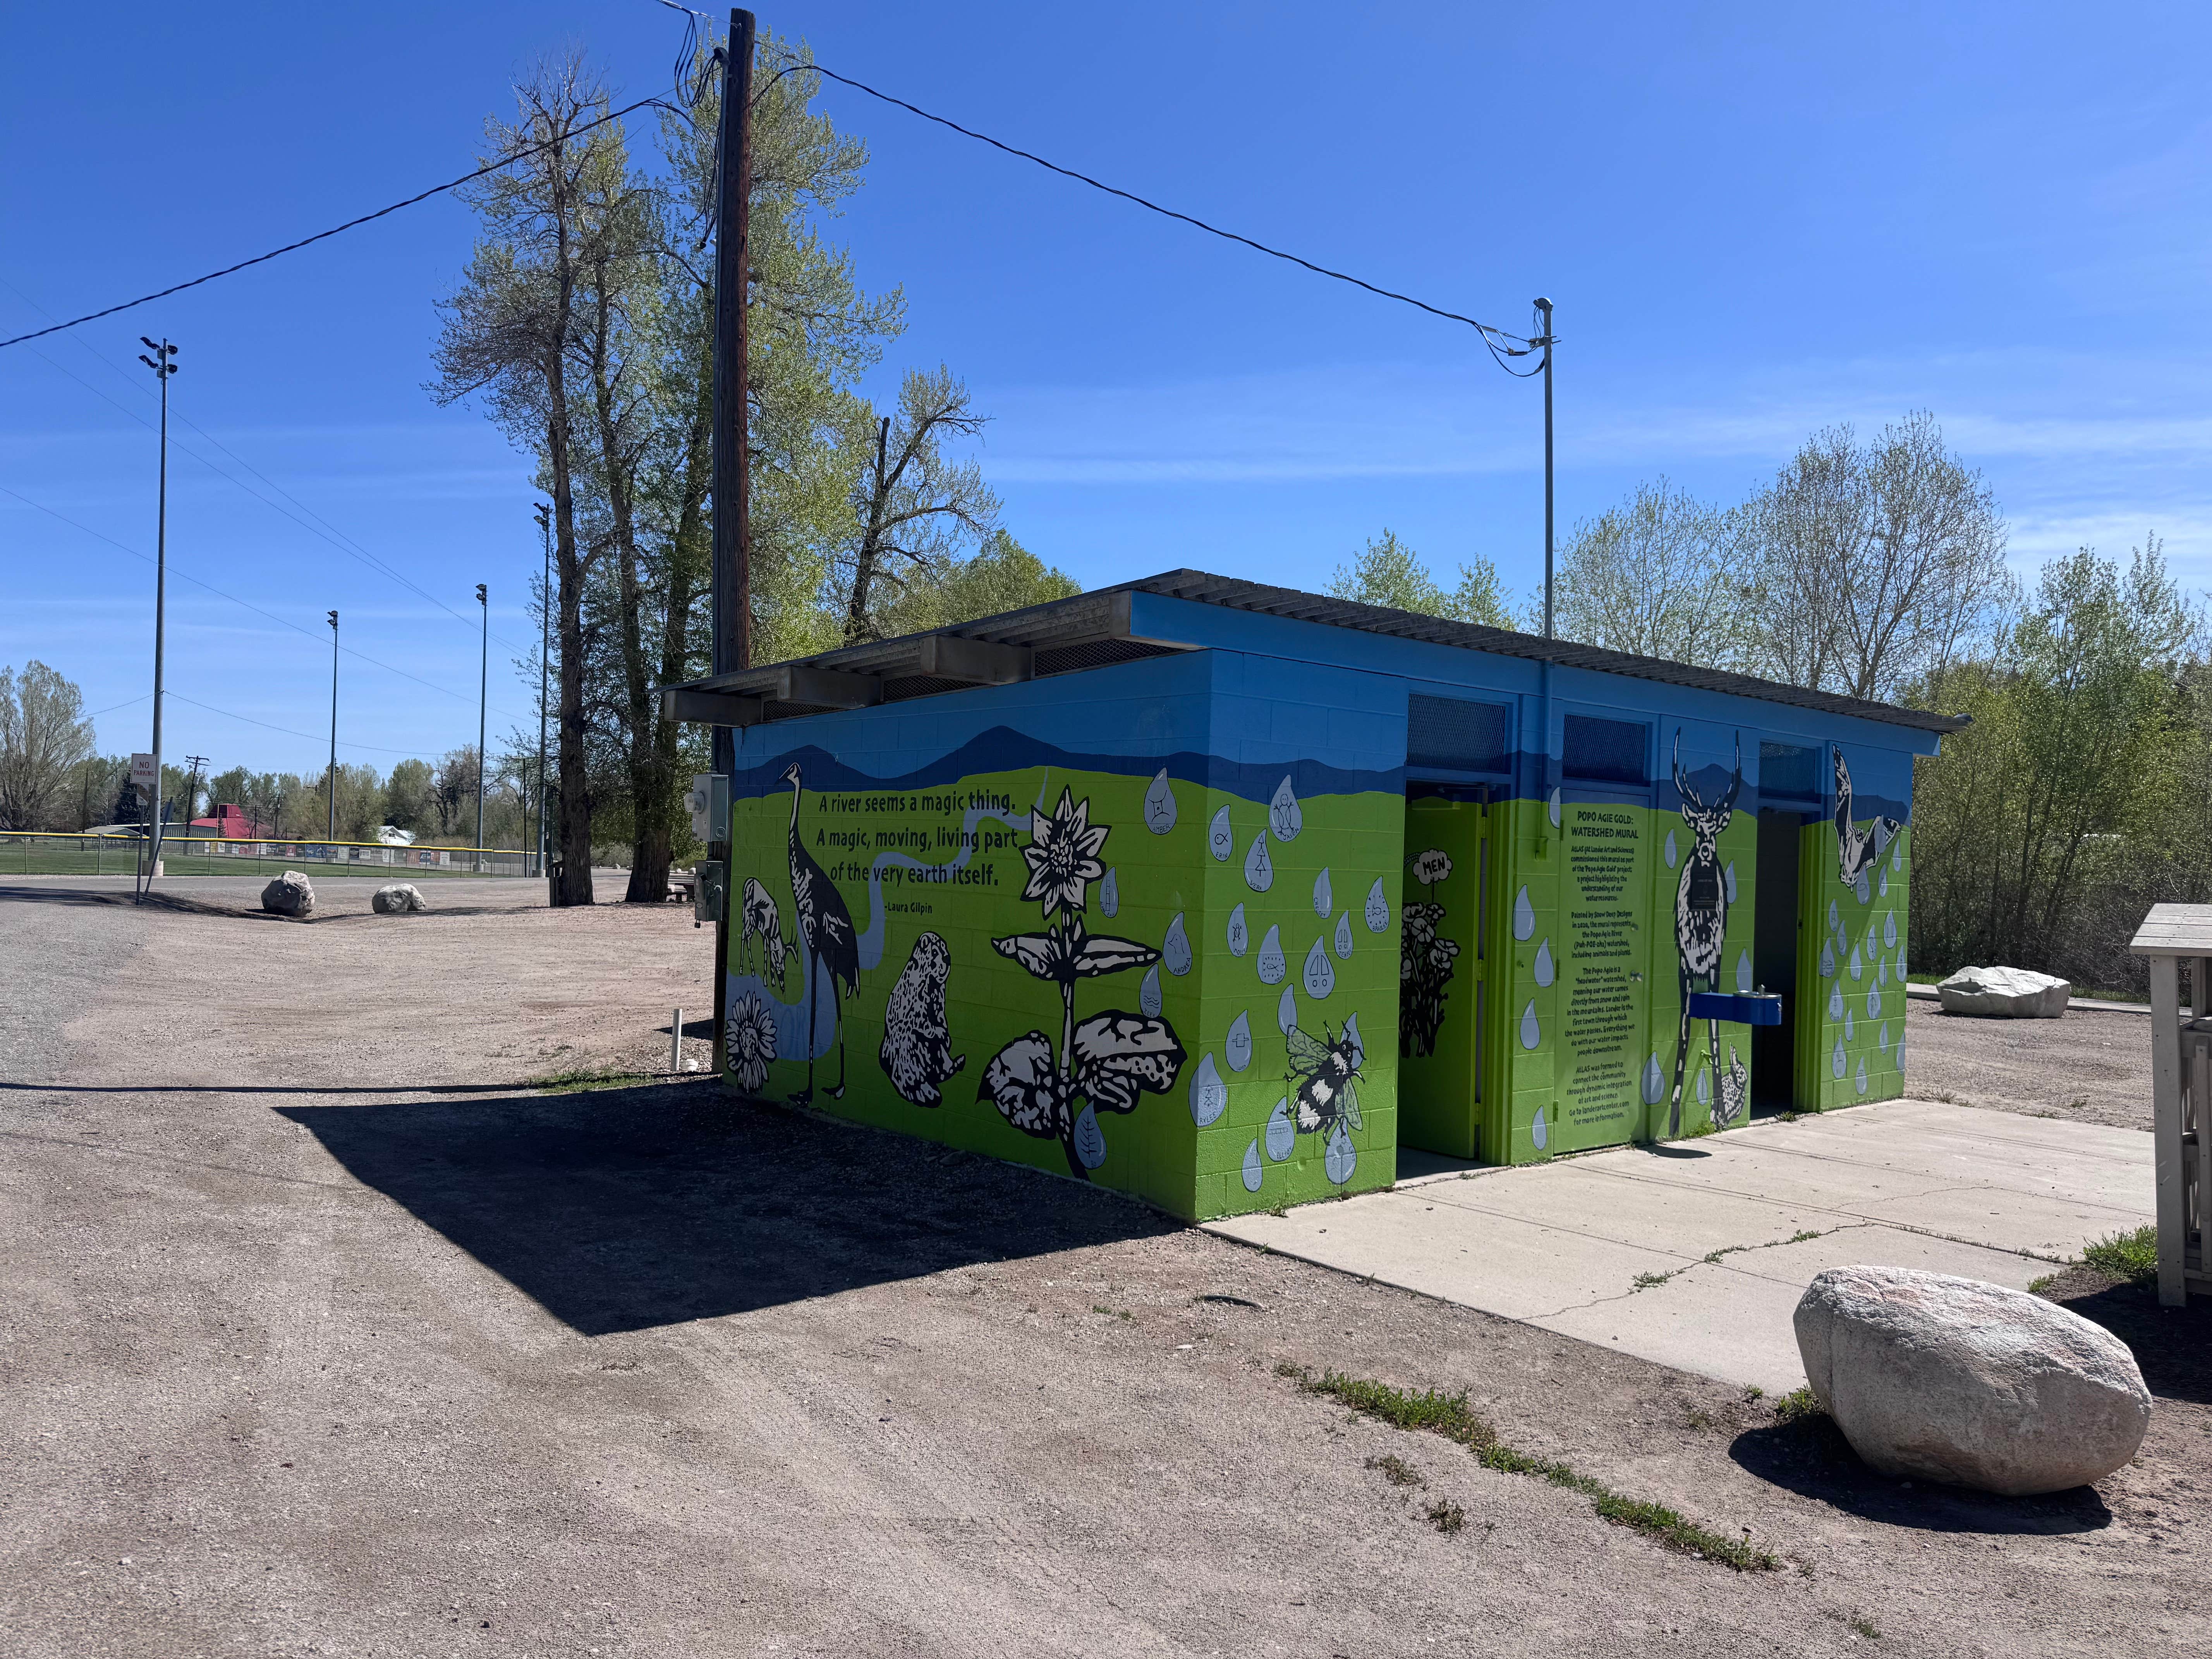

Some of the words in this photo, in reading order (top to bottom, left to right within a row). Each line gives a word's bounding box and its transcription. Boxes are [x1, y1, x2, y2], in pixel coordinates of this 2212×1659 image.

[819, 795, 827, 812] A
[831, 794, 861, 812] river
[865, 796, 905, 812] seems
[910, 797, 917, 811] a
[922, 791, 964, 816] magic
[969, 789, 1015, 816] thing.
[1578, 811, 1596, 821] POPO
[1597, 813, 1613, 822] AGIE
[1614, 814, 1633, 824] GOLD:
[1152, 824, 1170, 833] AMBER
[1283, 828, 1299, 840] JASON
[1571, 826, 1614, 837] WATERSHED
[1616, 829, 1638, 838] MURAL
[816, 828, 825, 846] A
[829, 828, 870, 852] magic,
[876, 827, 931, 852] moving,
[937, 827, 979, 852] living
[985, 828, 1017, 853] part
[1423, 857, 1445, 875] MEN
[1597, 866, 1605, 874] Agie
[831, 861, 844, 881] of
[847, 862, 869, 881] the
[874, 866, 903, 886] very
[908, 866, 947, 884] earth
[953, 864, 998, 885] itself.
[1250, 880, 1261, 890] VERA
[1580, 875, 1594, 884] project
[1595, 875, 1619, 883] highlighting
[884, 902, 908, 912] -Laura
[910, 902, 932, 914] Gilpin
[1617, 910, 1632, 919] Designs
[1173, 958, 1191, 974] ANDREA
[1592, 967, 1602, 975] Popo
[1573, 987, 1592, 995] meaning
[1571, 998, 1587, 1006] directly
[1580, 1006, 1605, 1015] mountains.
[1595, 1014, 1613, 1024] through
[1603, 1024, 1627, 1032] Everything
[1611, 1034, 1628, 1042] impacts
[1577, 1048, 1592, 1056] people
[1593, 1045, 1622, 1054] downstream.
[1601, 1061, 1617, 1070] formed
[1573, 1076, 1590, 1084] connect
[1601, 1070, 1626, 1080] community
[1567, 1086, 1585, 1095] through
[1587, 1083, 1605, 1093] dynamic
[1606, 1080, 1632, 1089] integration
[1592, 1093, 1601, 1101] and
[1582, 1101, 1629, 1114] landerartcenter.com
[1200, 1111, 1216, 1124] RYLEE
[1277, 1147, 1291, 1159] ELLIOT
